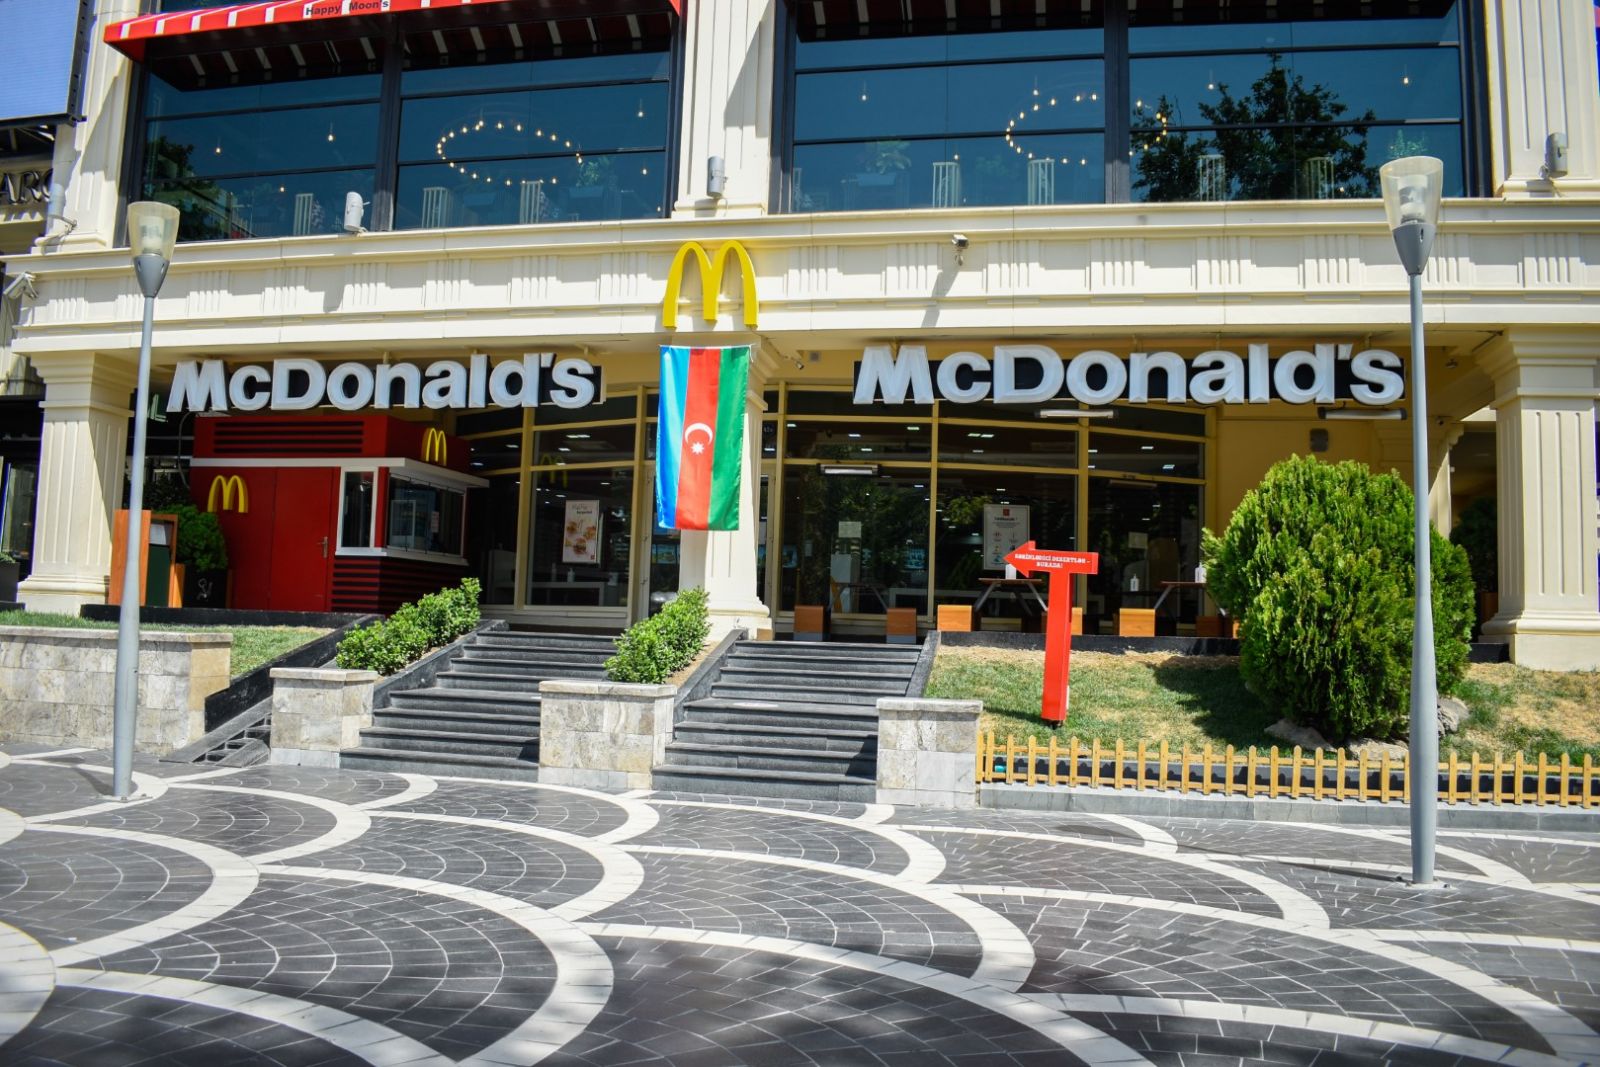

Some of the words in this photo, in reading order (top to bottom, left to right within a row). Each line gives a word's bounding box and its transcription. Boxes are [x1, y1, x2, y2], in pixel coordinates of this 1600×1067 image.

[305, 5, 341, 16] Happy
[166, 352, 597, 412] McDonald's
[853, 343, 1405, 404] McDonald's
